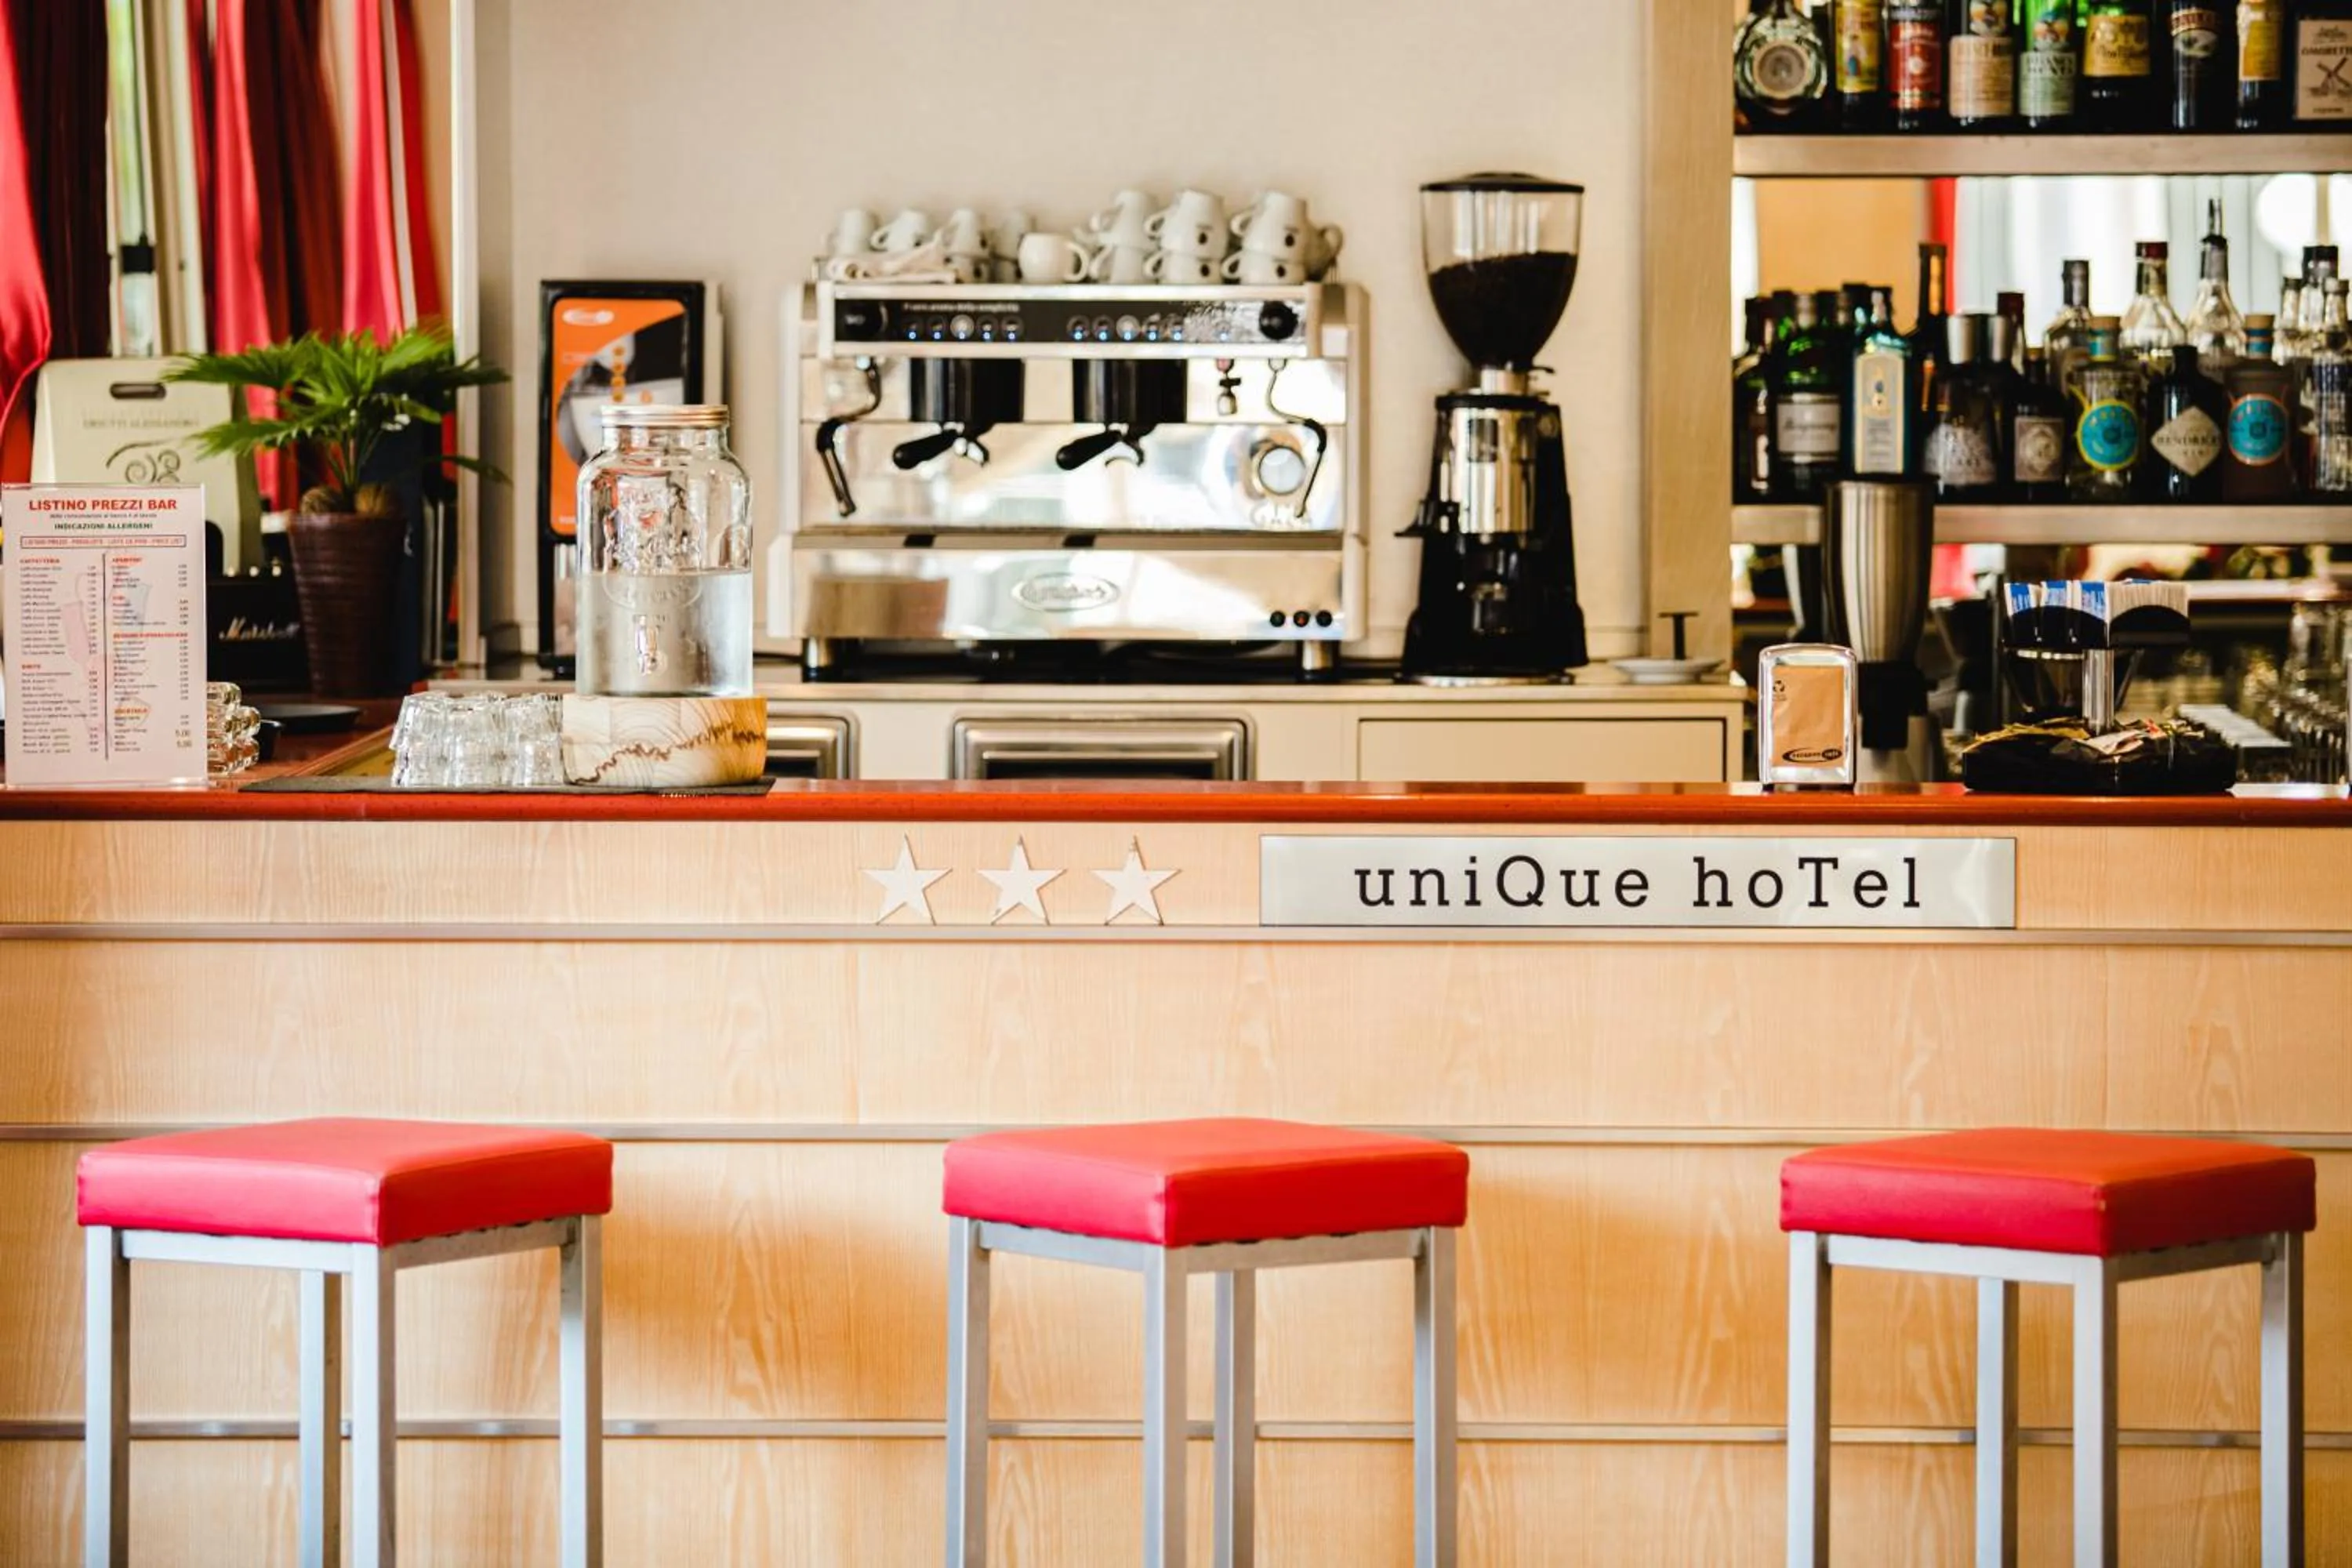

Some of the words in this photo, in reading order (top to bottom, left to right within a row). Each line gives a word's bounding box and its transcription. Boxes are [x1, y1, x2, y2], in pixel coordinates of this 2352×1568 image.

[29, 499, 87, 510] LISTINO
[92, 499, 142, 510] PREZZI
[148, 499, 177, 510] BAR
[1354, 855, 1650, 908] uniQue
[1692, 856, 1921, 909] hoTel
